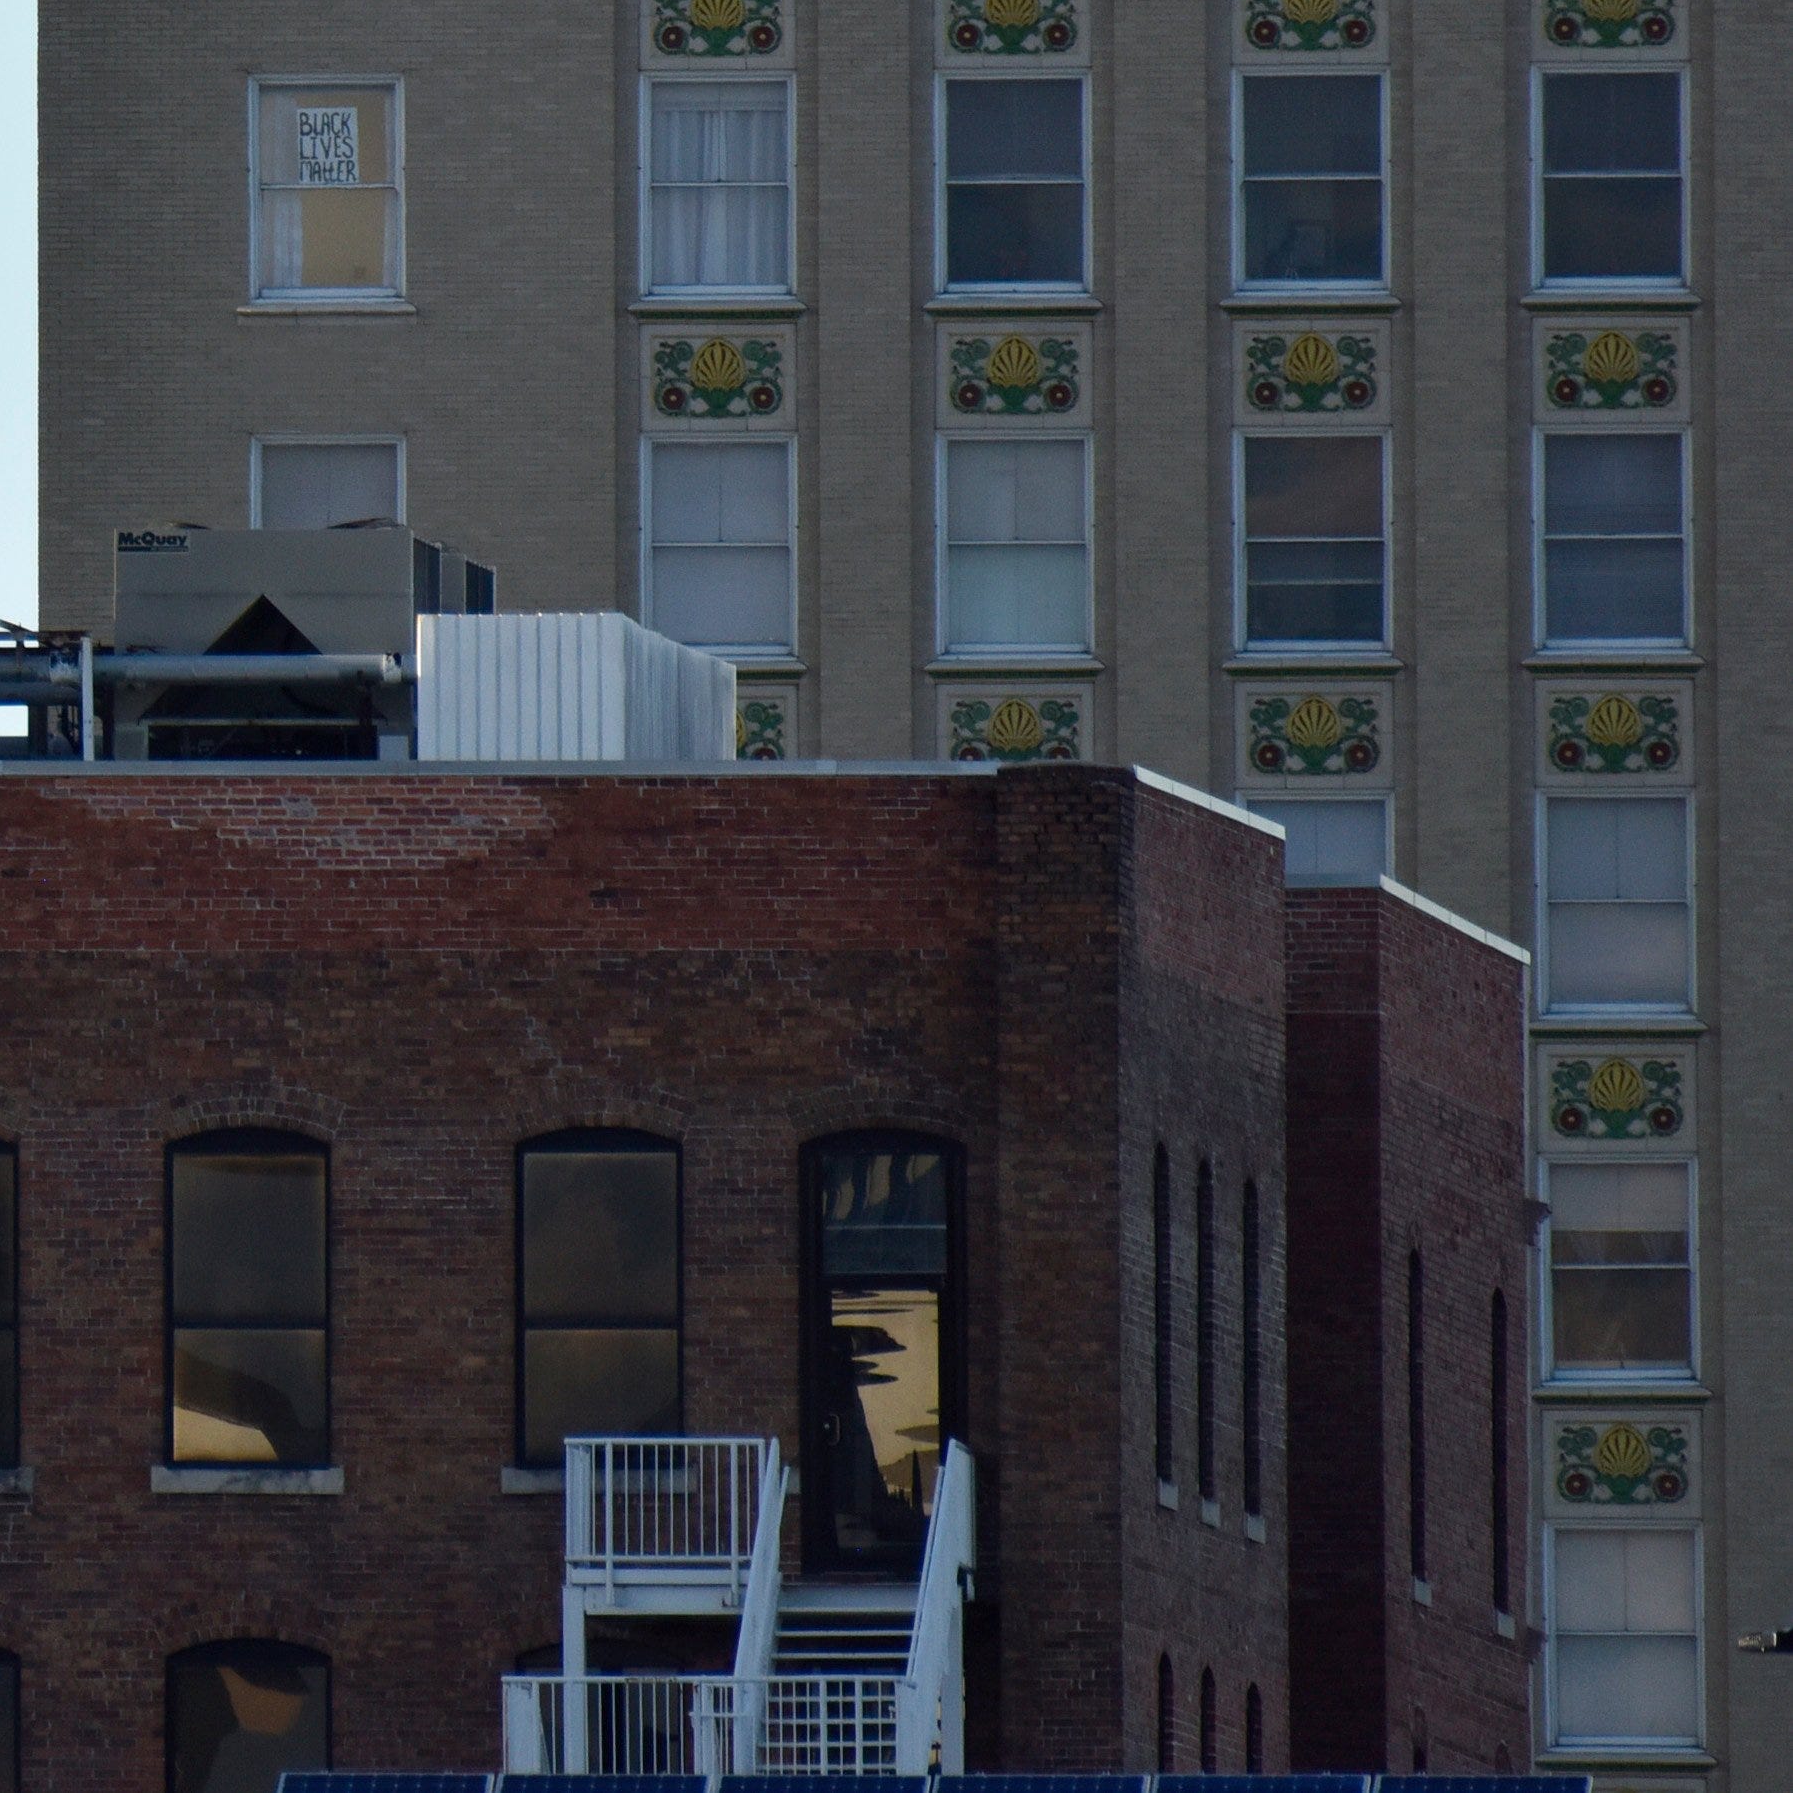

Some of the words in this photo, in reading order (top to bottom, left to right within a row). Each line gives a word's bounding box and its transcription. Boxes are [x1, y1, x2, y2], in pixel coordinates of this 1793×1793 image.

[299, 112, 351, 137] BLACK
[299, 135, 354, 160] LIVES
[117, 531, 187, 548] McQuay
